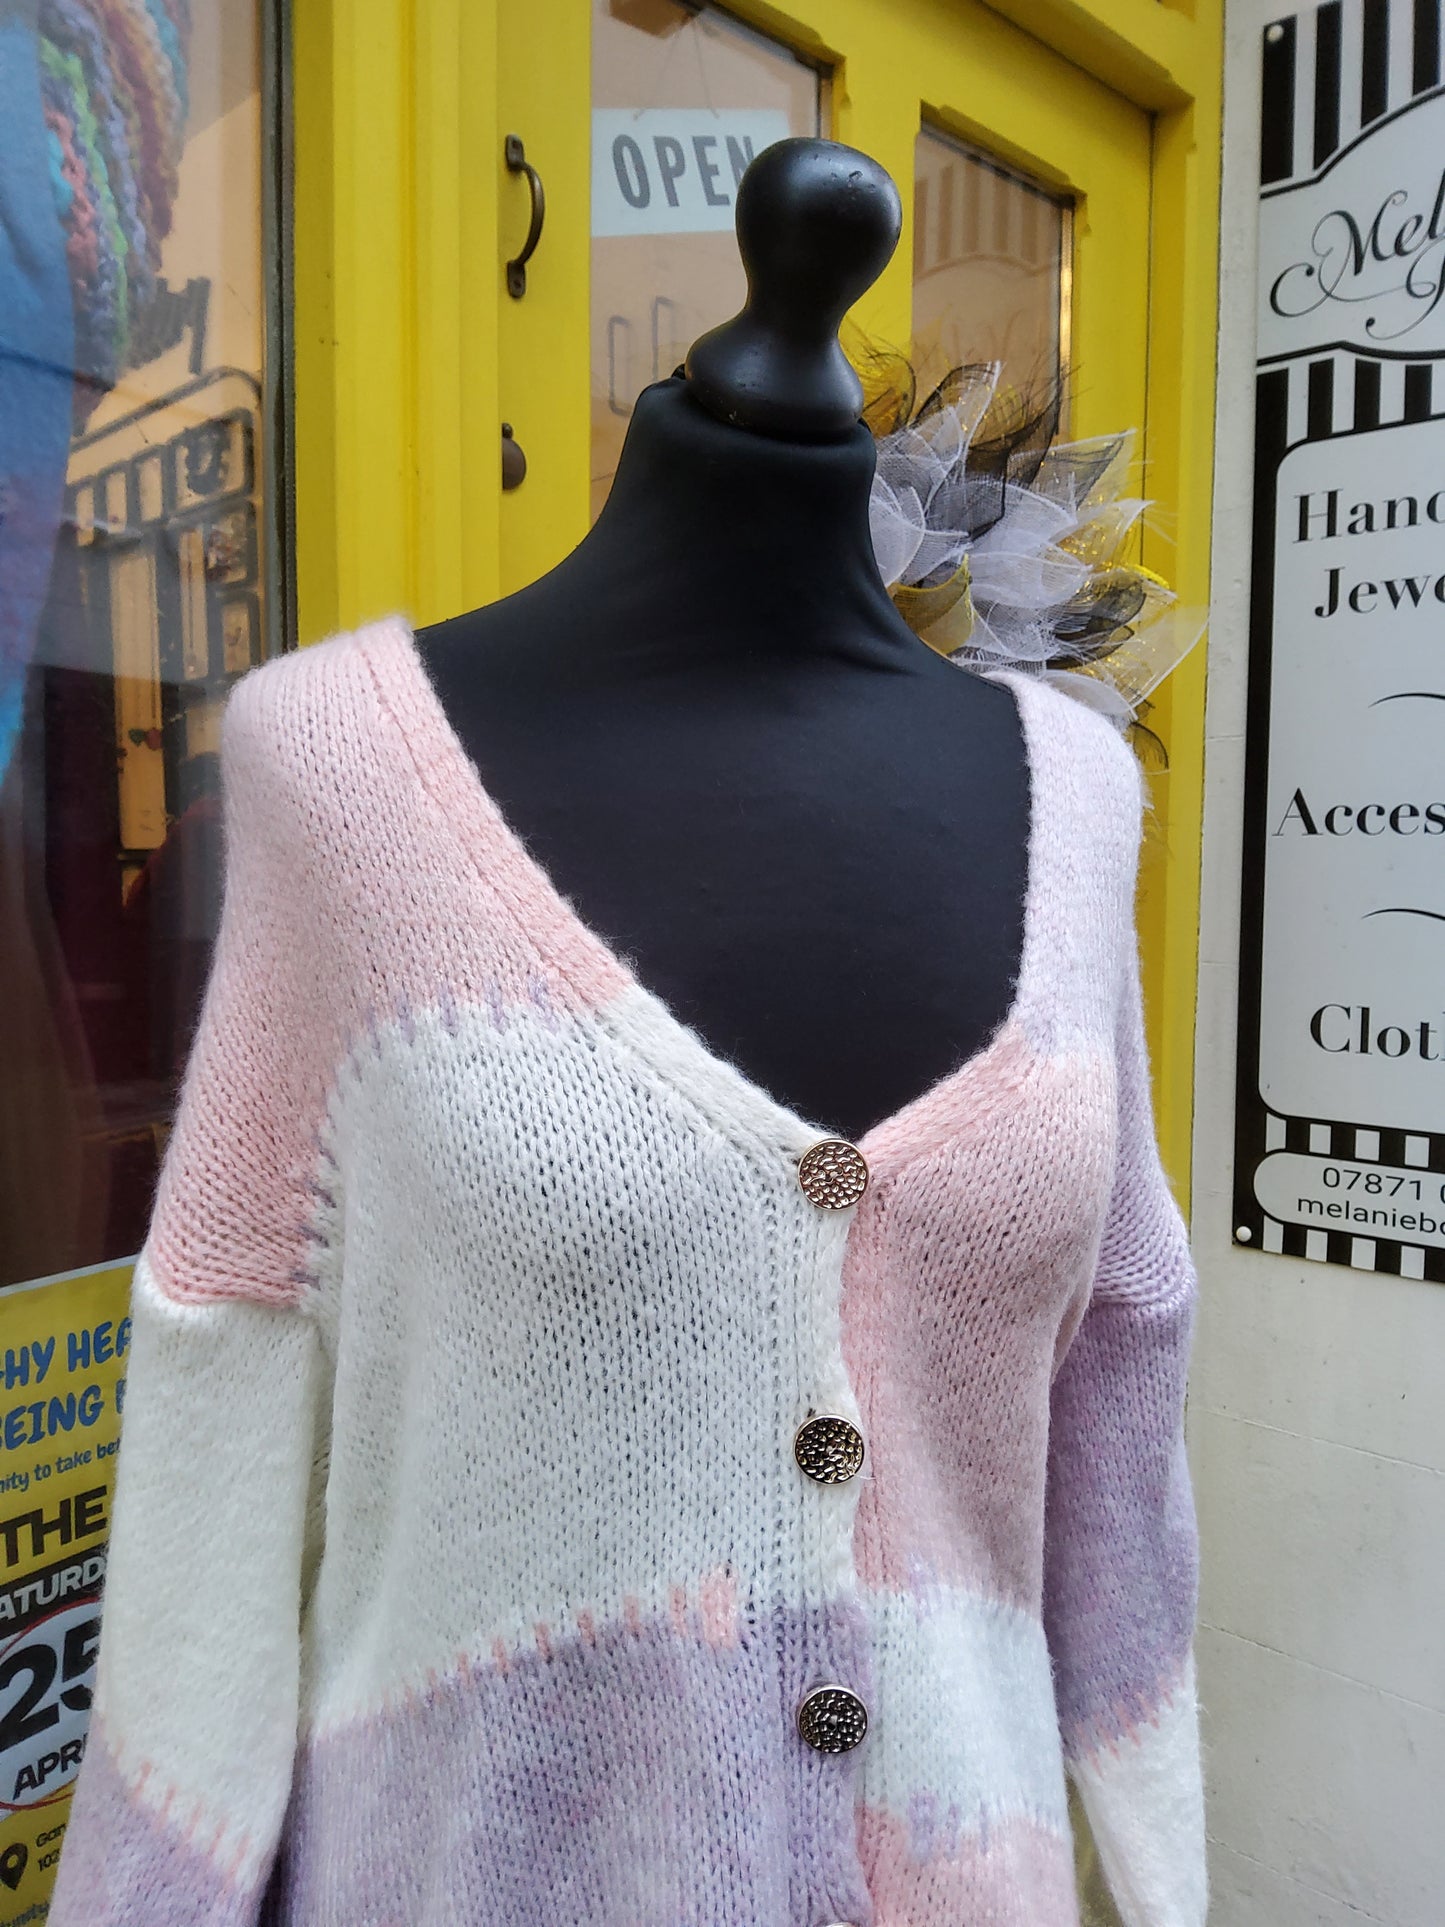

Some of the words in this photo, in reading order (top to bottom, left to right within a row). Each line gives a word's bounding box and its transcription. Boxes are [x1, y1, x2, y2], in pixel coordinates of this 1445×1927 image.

[612, 134, 755, 209] OPEN
[1310, 1003, 1445, 1062] Clot
[1323, 1167, 1421, 1201] 07871
[0, 1335, 55, 1390] HY
[0, 1384, 104, 1450] EING
[34, 1463, 51, 1481] to
[55, 1449, 92, 1474] take
[0, 1484, 107, 1567] THE
